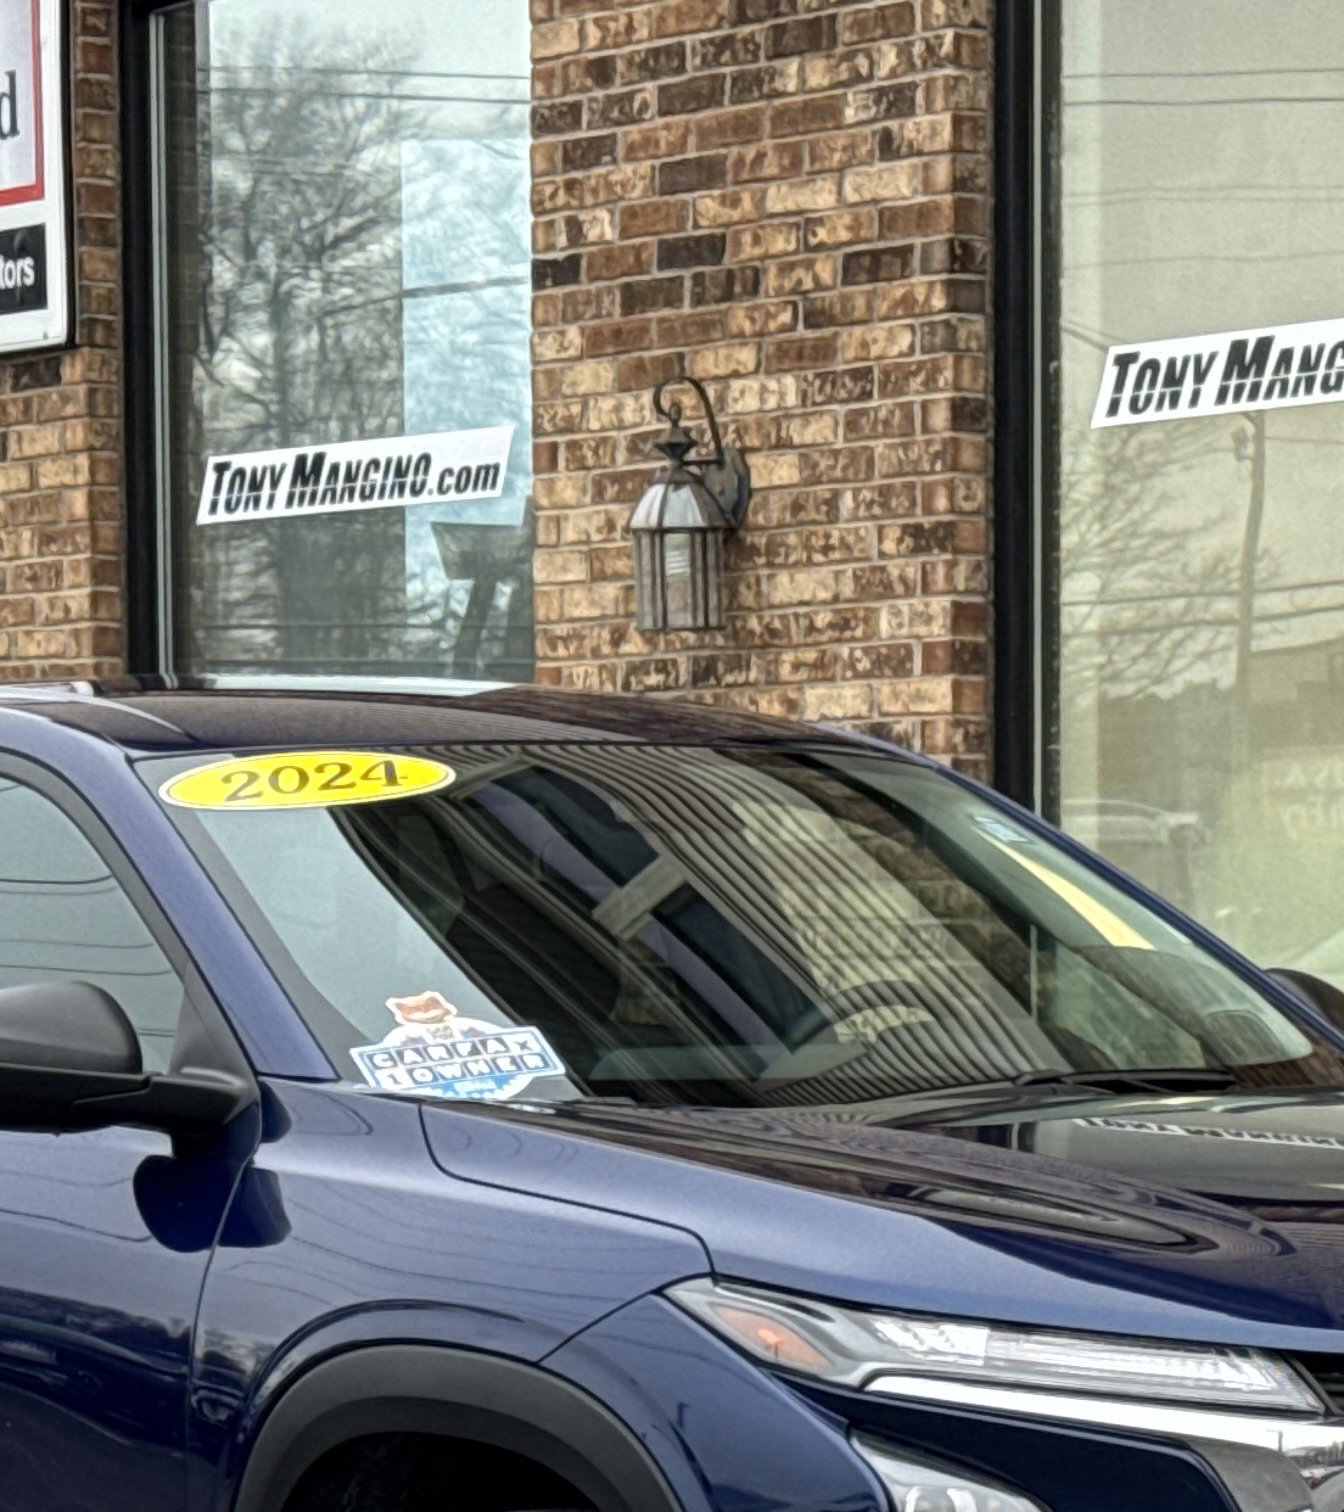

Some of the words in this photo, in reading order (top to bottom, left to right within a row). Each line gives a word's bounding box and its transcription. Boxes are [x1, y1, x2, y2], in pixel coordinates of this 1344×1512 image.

[220, 759, 409, 803] 2024
[371, 1039, 535, 1070] CARFAX
[412, 1053, 549, 1084] OWNER
